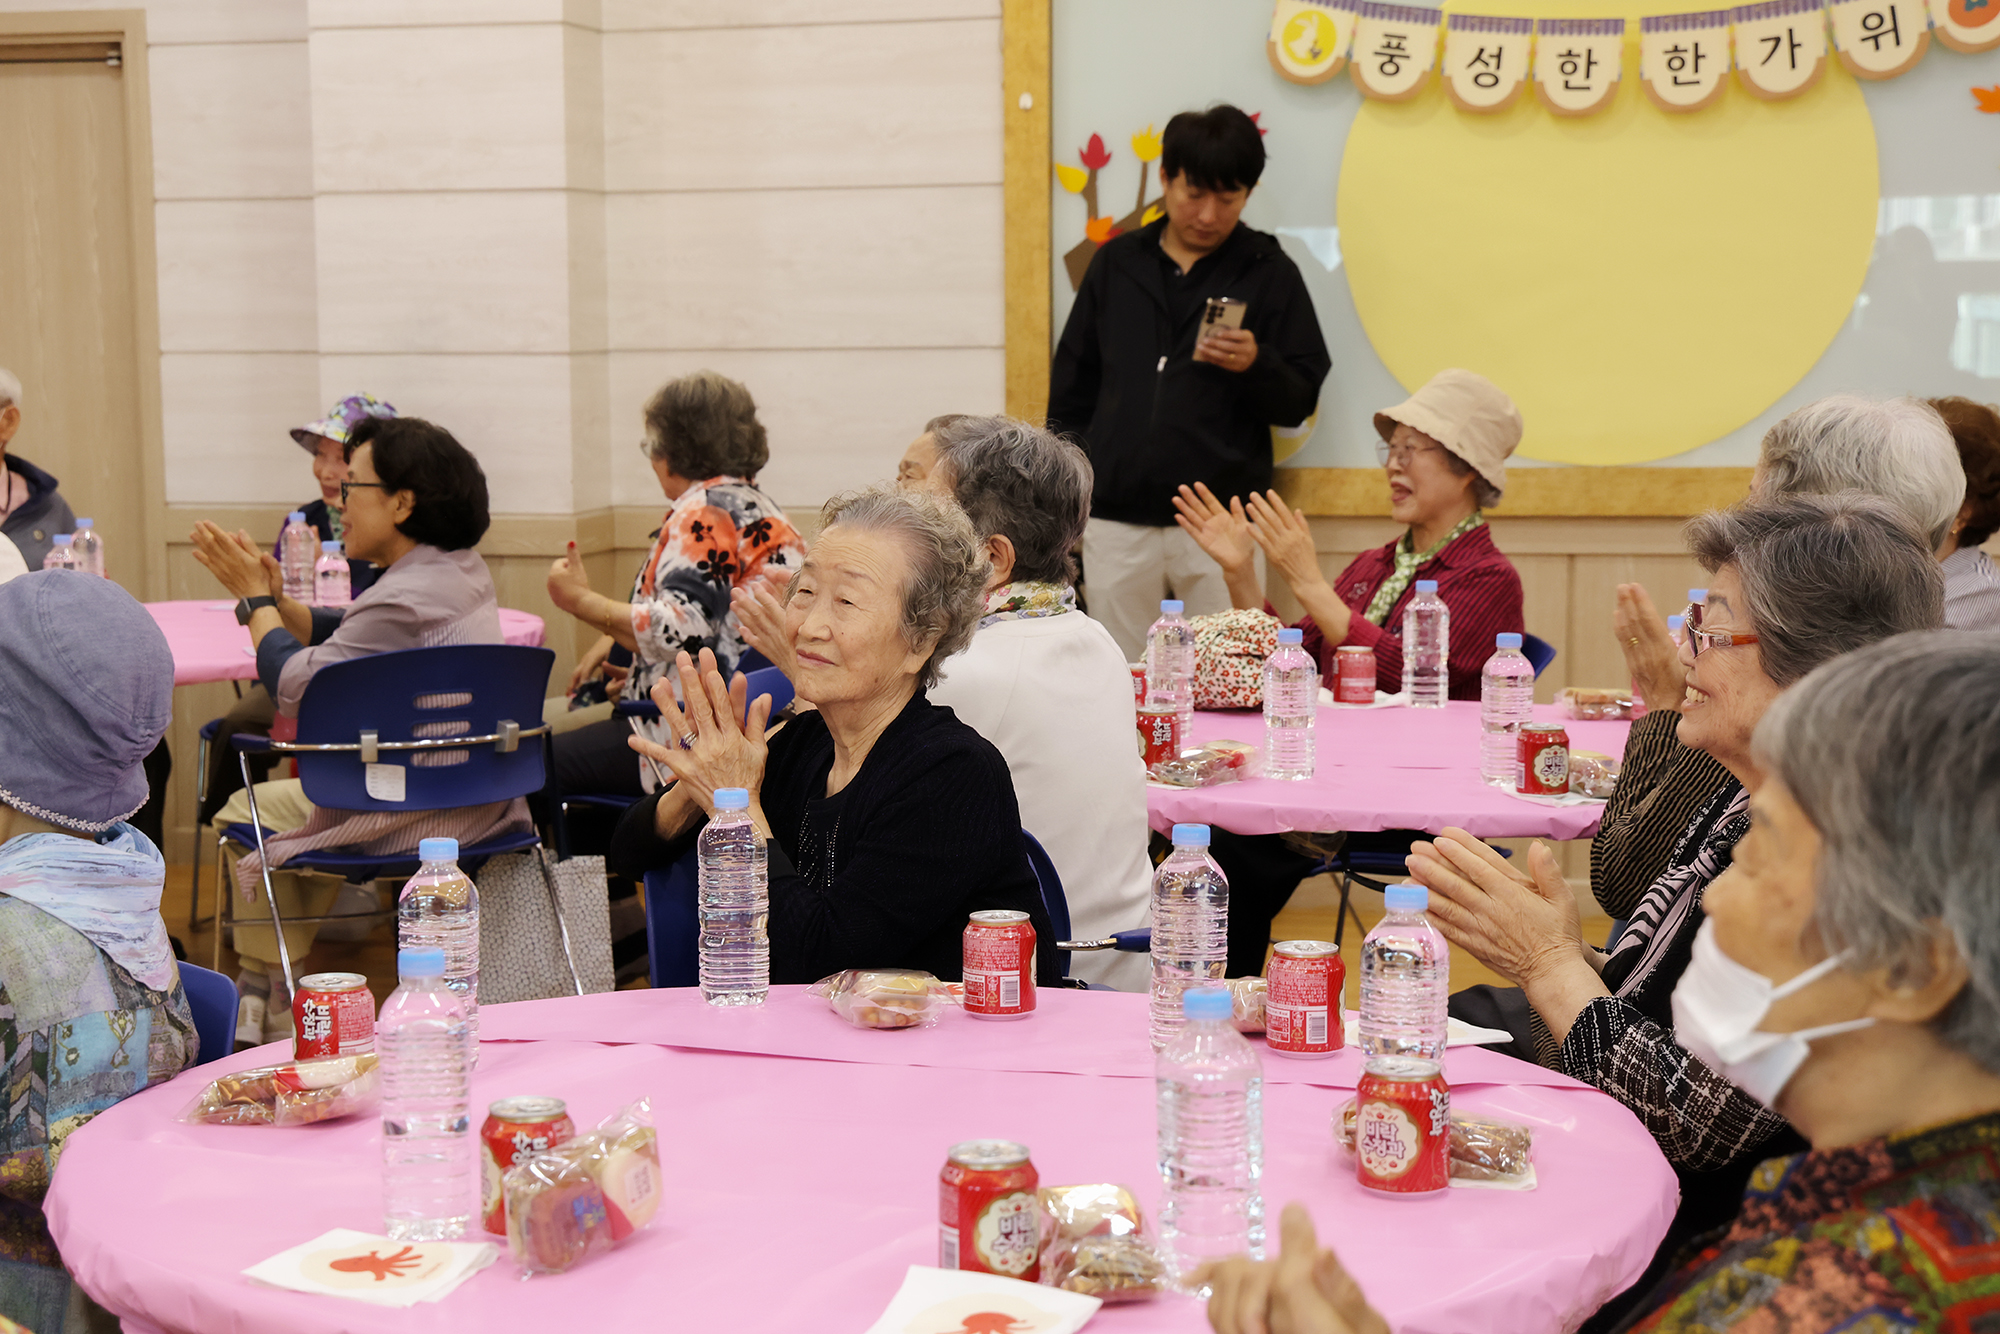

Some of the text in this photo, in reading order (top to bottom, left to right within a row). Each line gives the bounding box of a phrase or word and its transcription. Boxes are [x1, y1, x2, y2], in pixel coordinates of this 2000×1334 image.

[1373, 4, 1902, 91] 풍성한 한가위
[1152, 717, 1163, 747] 수정과
[302, 998, 317, 1042] 수정과
[314, 1004, 333, 1037] 비락
[1429, 1088, 1444, 1137] 수정과
[1361, 1135, 1407, 1160] 수정과
[1364, 1120, 1399, 1142] 비락
